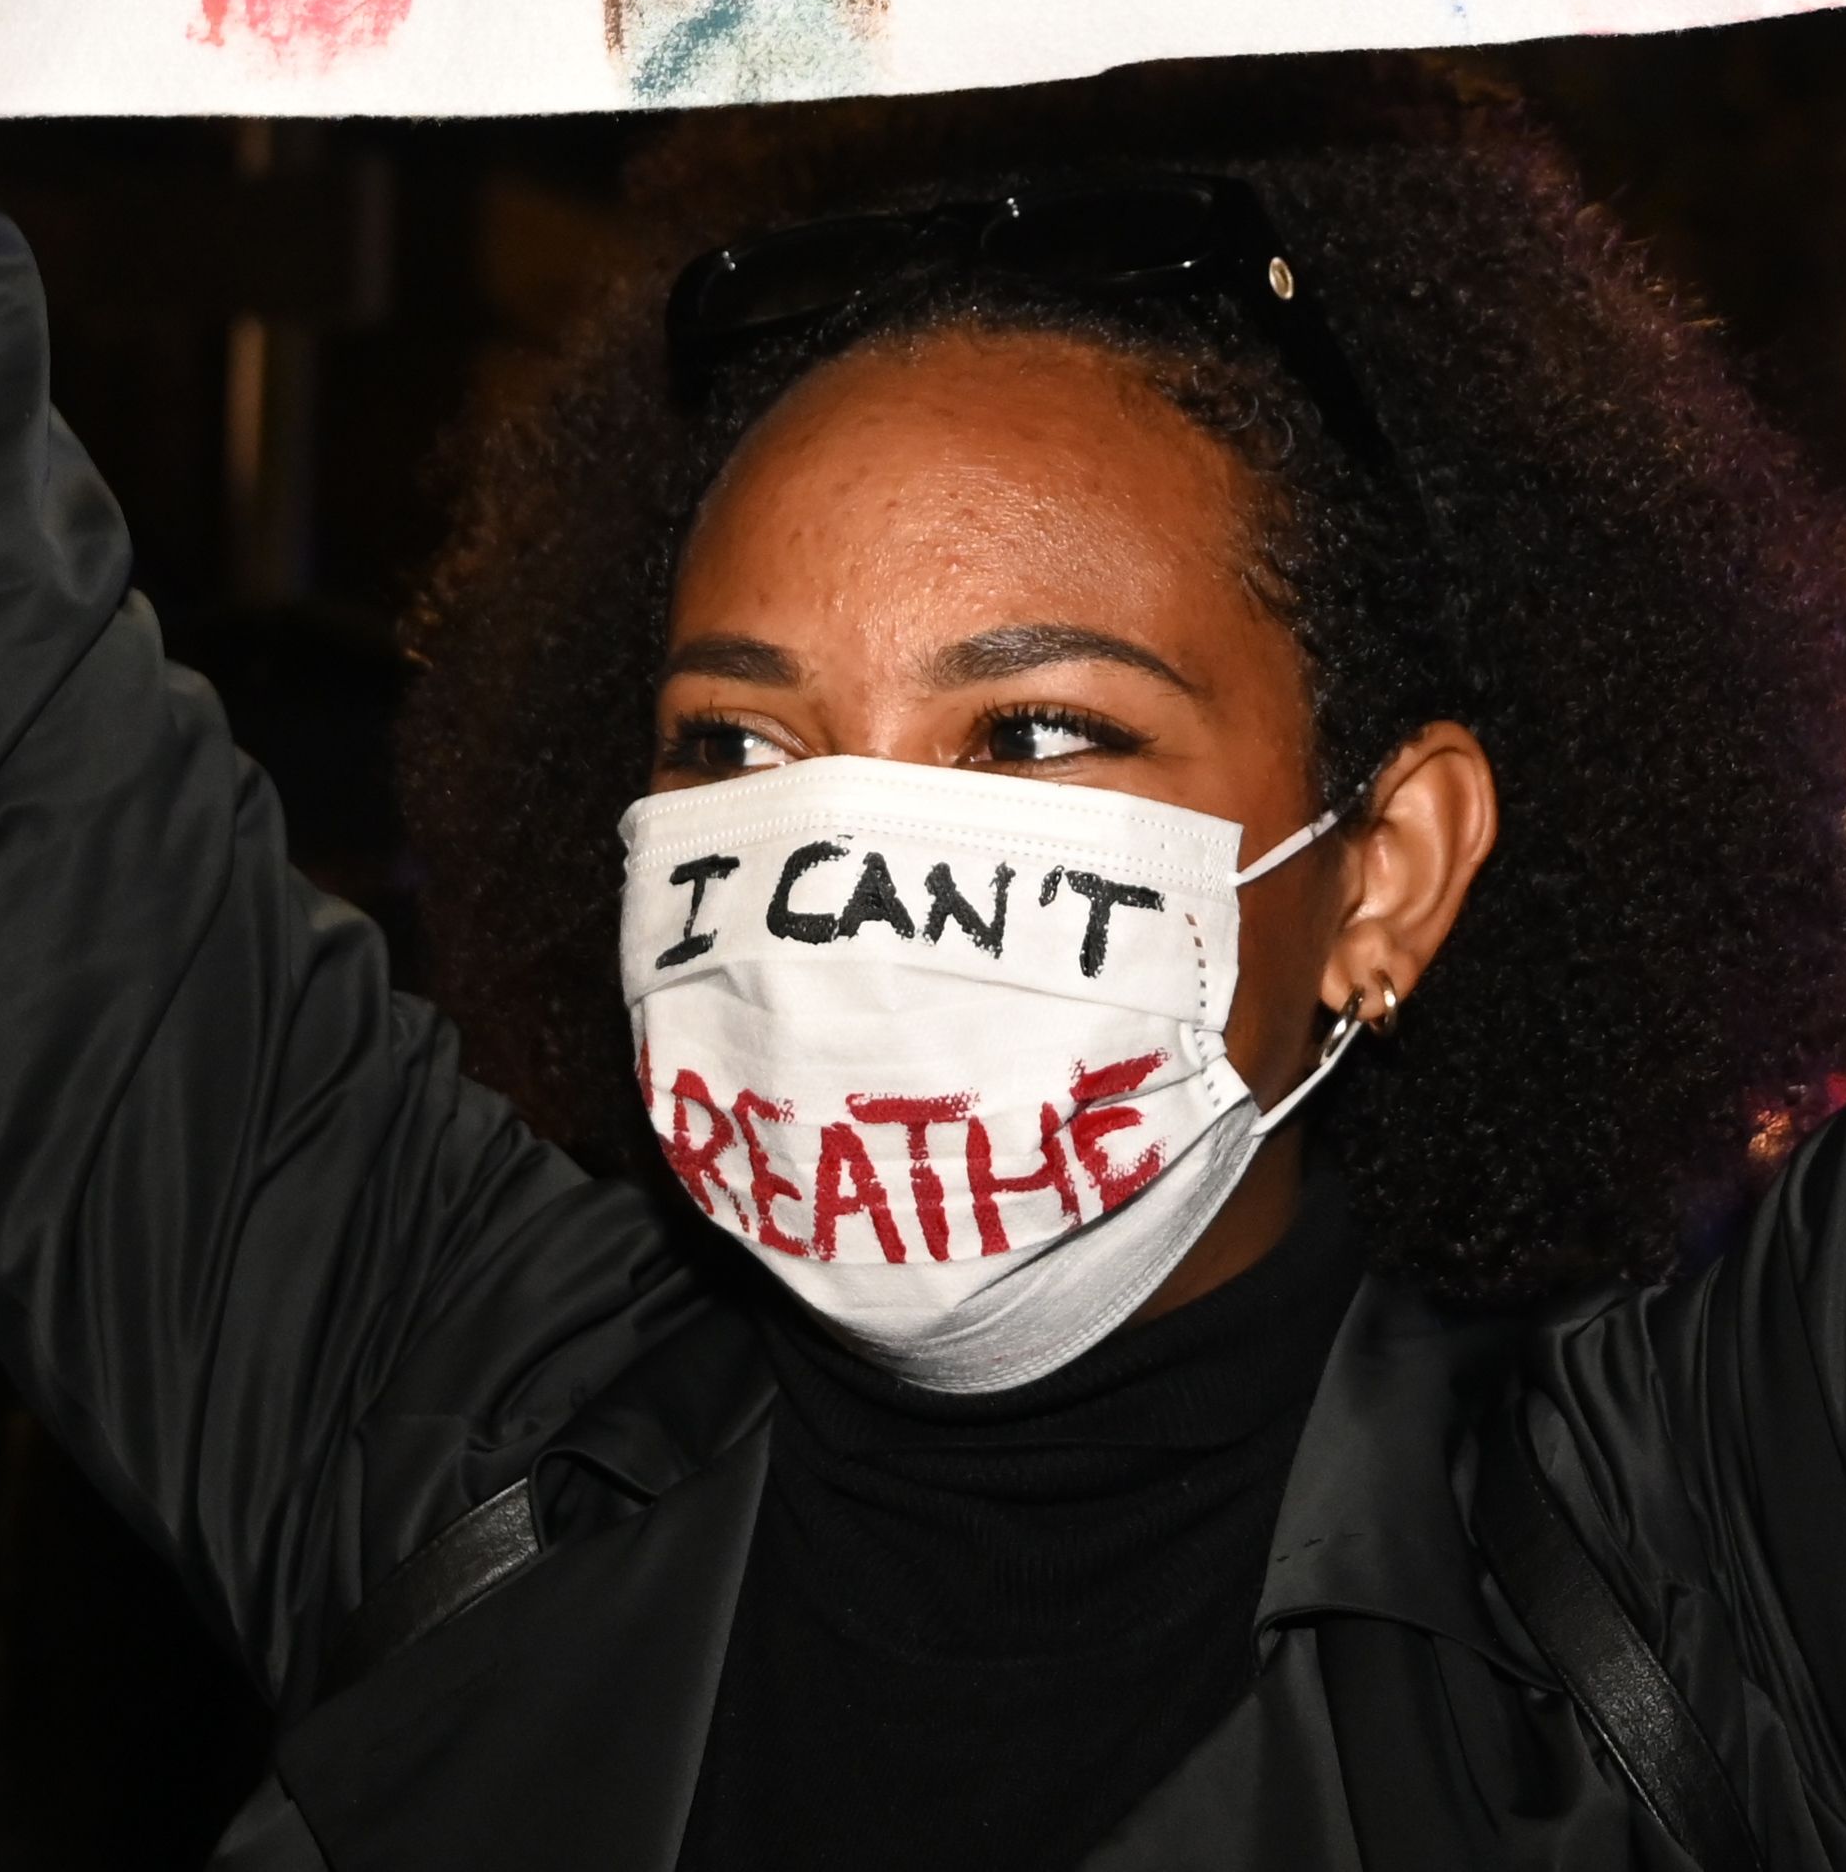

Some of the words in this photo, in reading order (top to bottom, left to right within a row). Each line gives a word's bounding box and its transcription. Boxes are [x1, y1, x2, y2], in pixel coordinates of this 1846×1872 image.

[655, 855, 740, 970] I
[766, 834, 1165, 978] CAN'T
[636, 1039, 1172, 1264] REATHE
